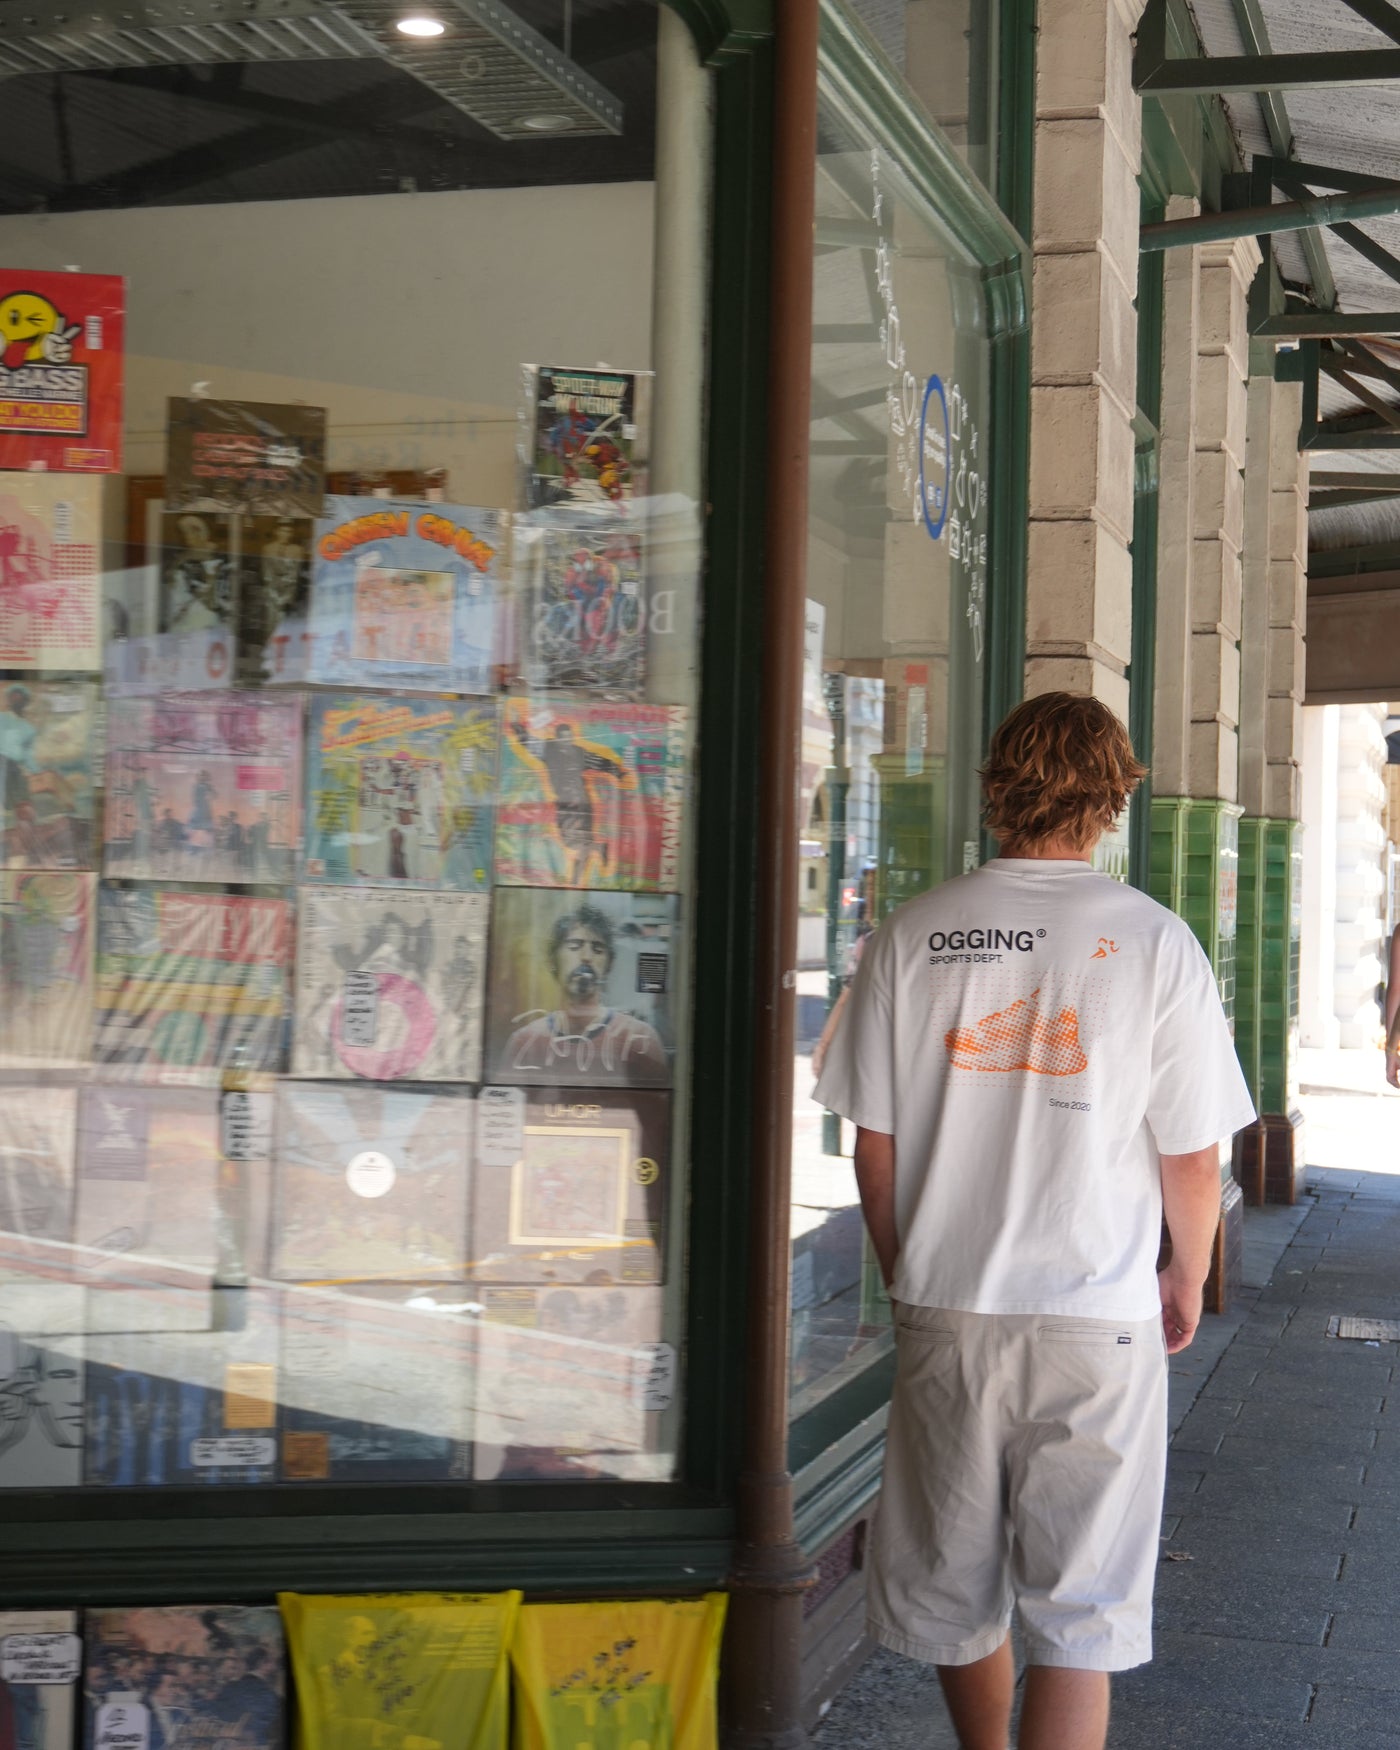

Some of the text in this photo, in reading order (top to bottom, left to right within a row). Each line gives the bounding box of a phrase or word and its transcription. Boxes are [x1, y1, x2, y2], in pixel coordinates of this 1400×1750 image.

[12, 368, 83, 391] BASS
[929, 954, 1004, 965] SPORTS DEPT.
[1048, 1098, 1092, 1112] Since 2020
